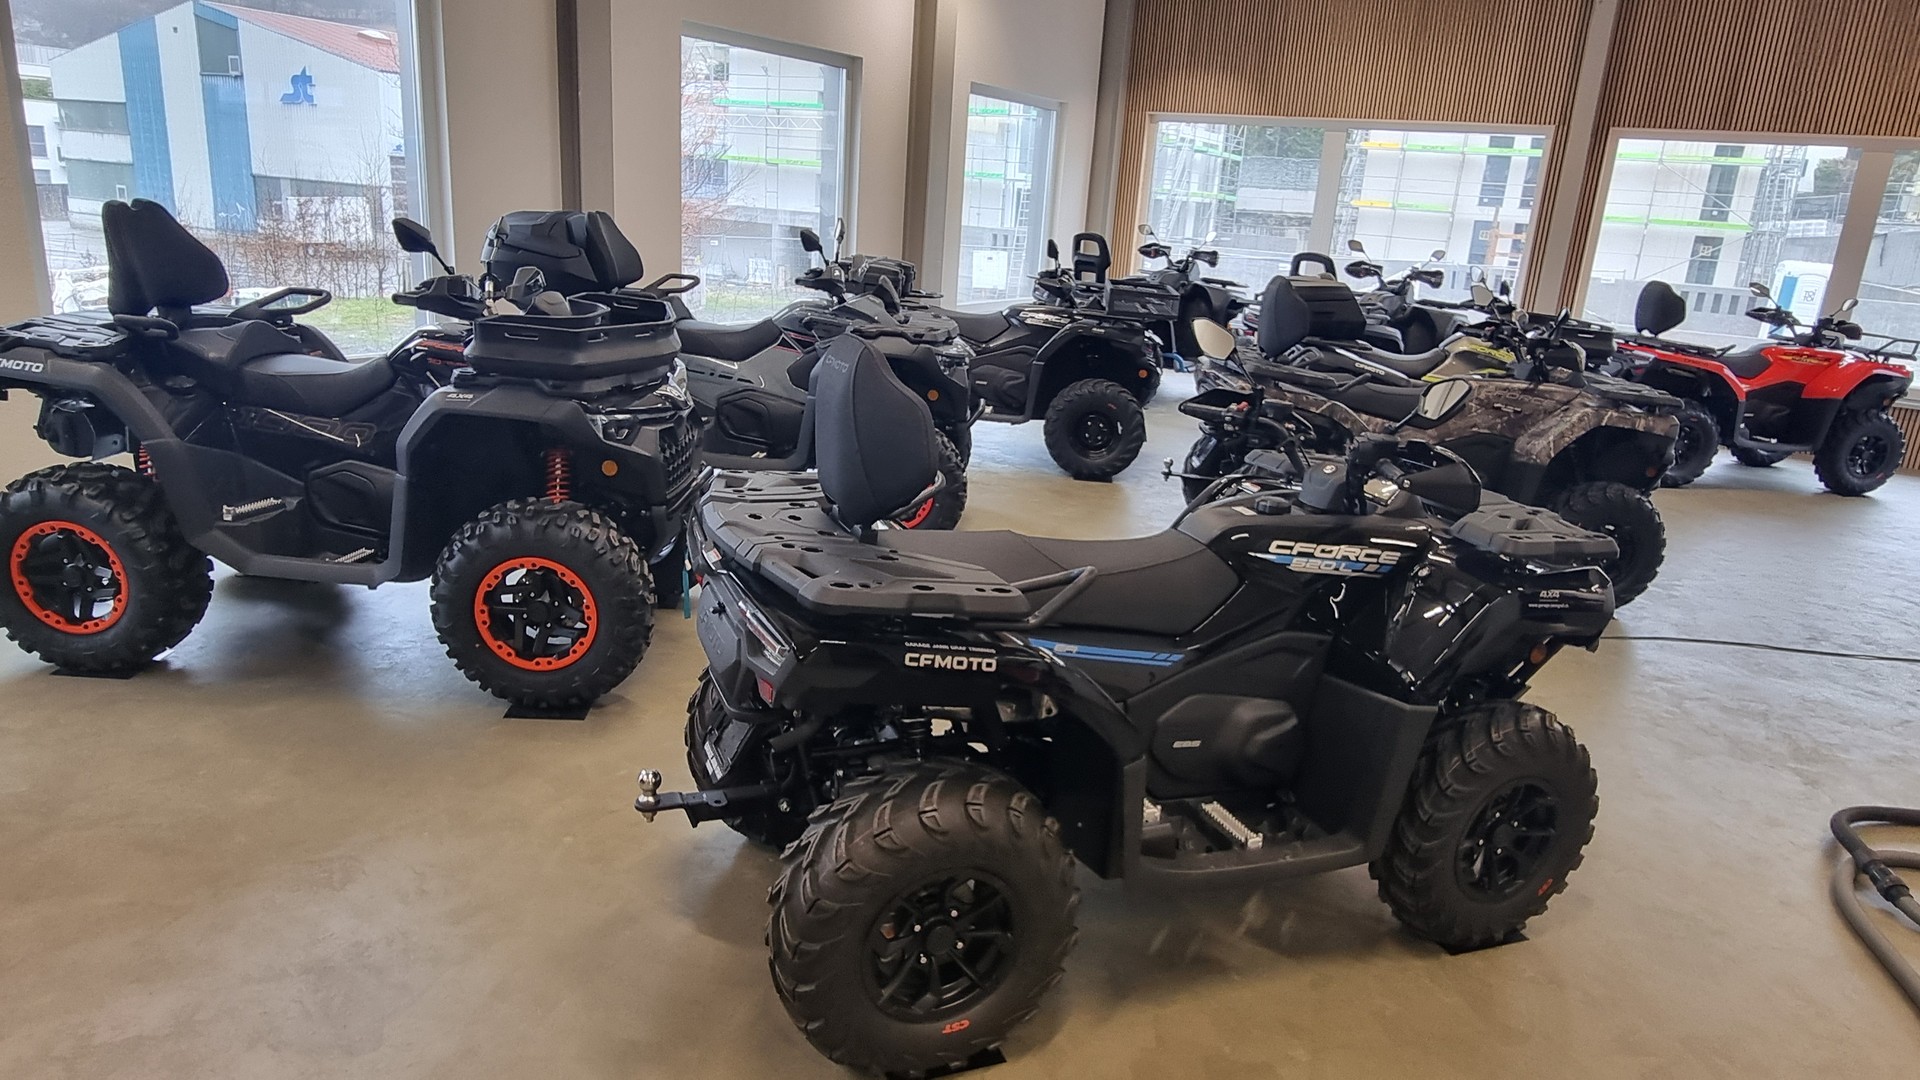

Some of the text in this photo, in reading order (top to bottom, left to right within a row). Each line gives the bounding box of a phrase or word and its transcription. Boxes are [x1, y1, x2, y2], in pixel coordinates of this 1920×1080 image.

[0, 358, 44, 372] MOTO
[1268, 540, 1401, 564] CFORCE
[1290, 557, 1334, 571] 520
[904, 653, 997, 672] CFMOTO
